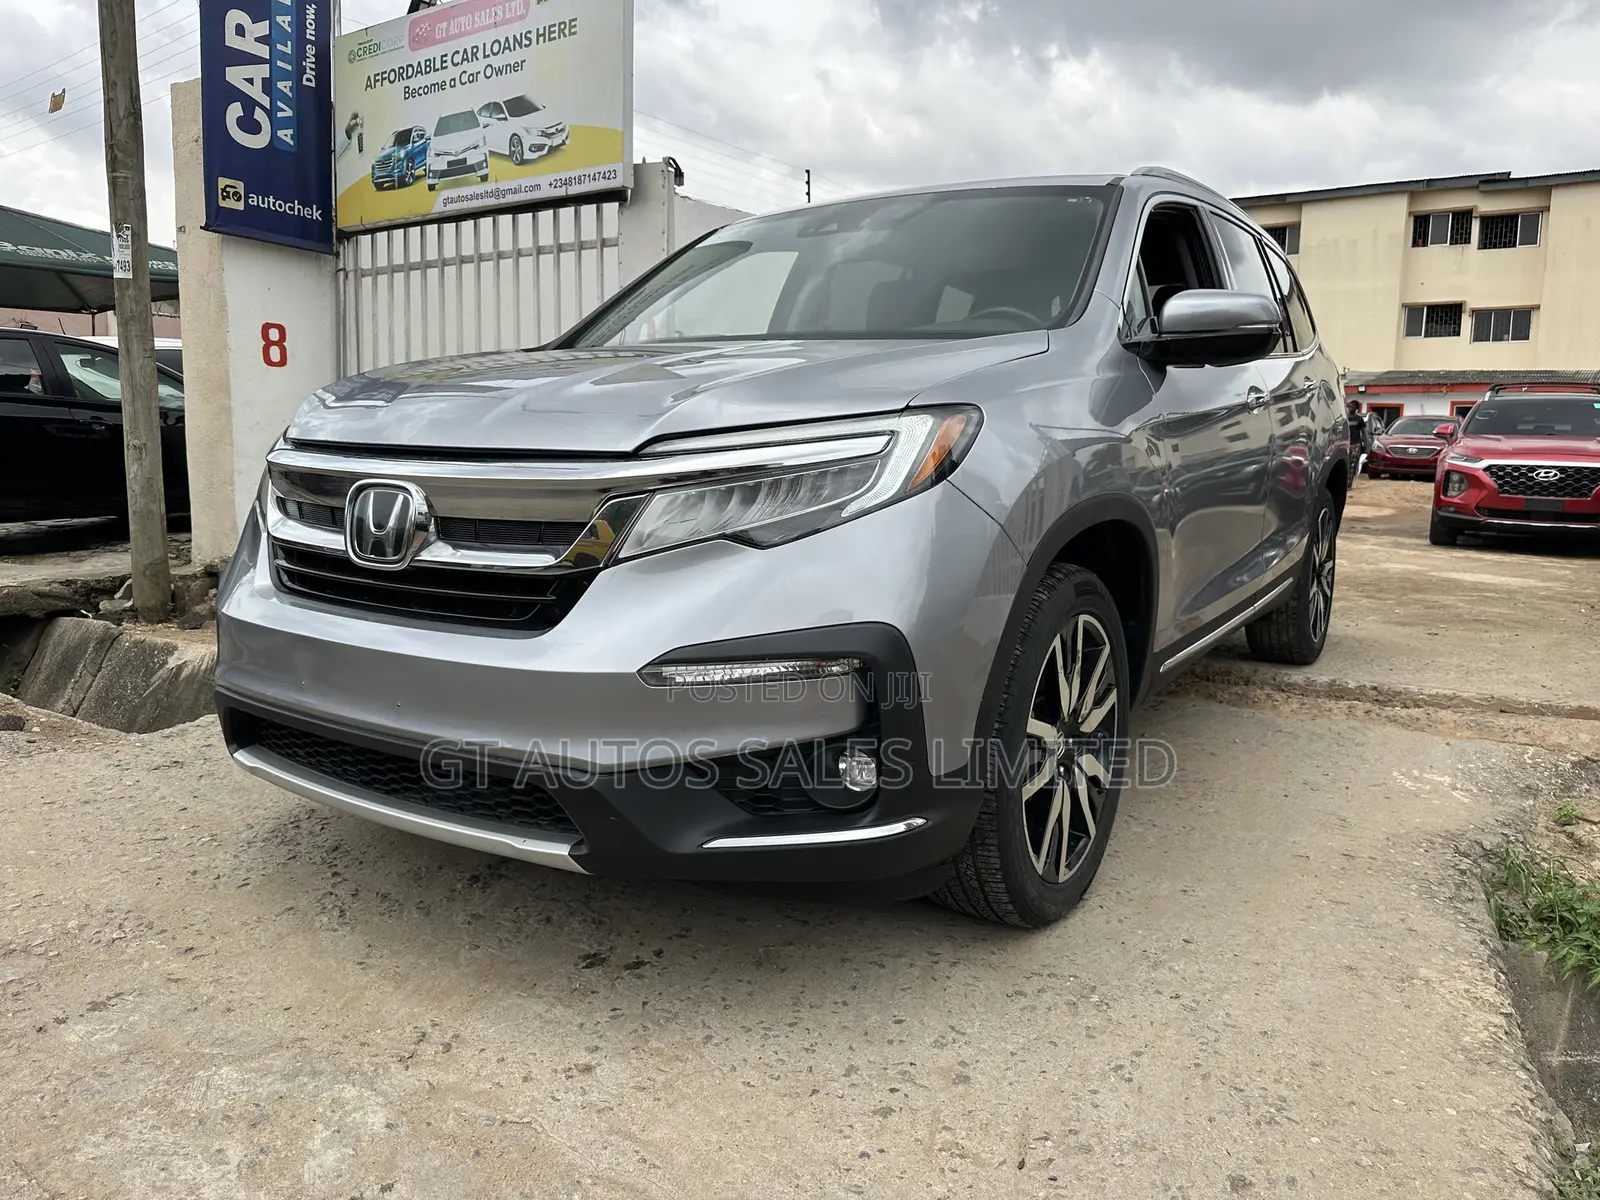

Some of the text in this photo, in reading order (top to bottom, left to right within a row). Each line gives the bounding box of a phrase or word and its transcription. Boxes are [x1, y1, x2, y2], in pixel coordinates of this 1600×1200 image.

[435, 1, 526, 39] GT AUTO SALES LTD.
[302, 3, 317, 88] Drive now,
[364, 53, 448, 92] AFFORDABLE
[450, 44, 480, 68] CAR
[482, 30, 532, 59] LOANS
[536, 17, 578, 46] HERE
[225, 8, 271, 149] CAR
[403, 59, 526, 101] Become a Car Owner
[248, 192, 322, 221] autochek
[442, 169, 618, 208] gtautosalesltd@gmail.com +2348187147423
[261, 321, 288, 368] 8
